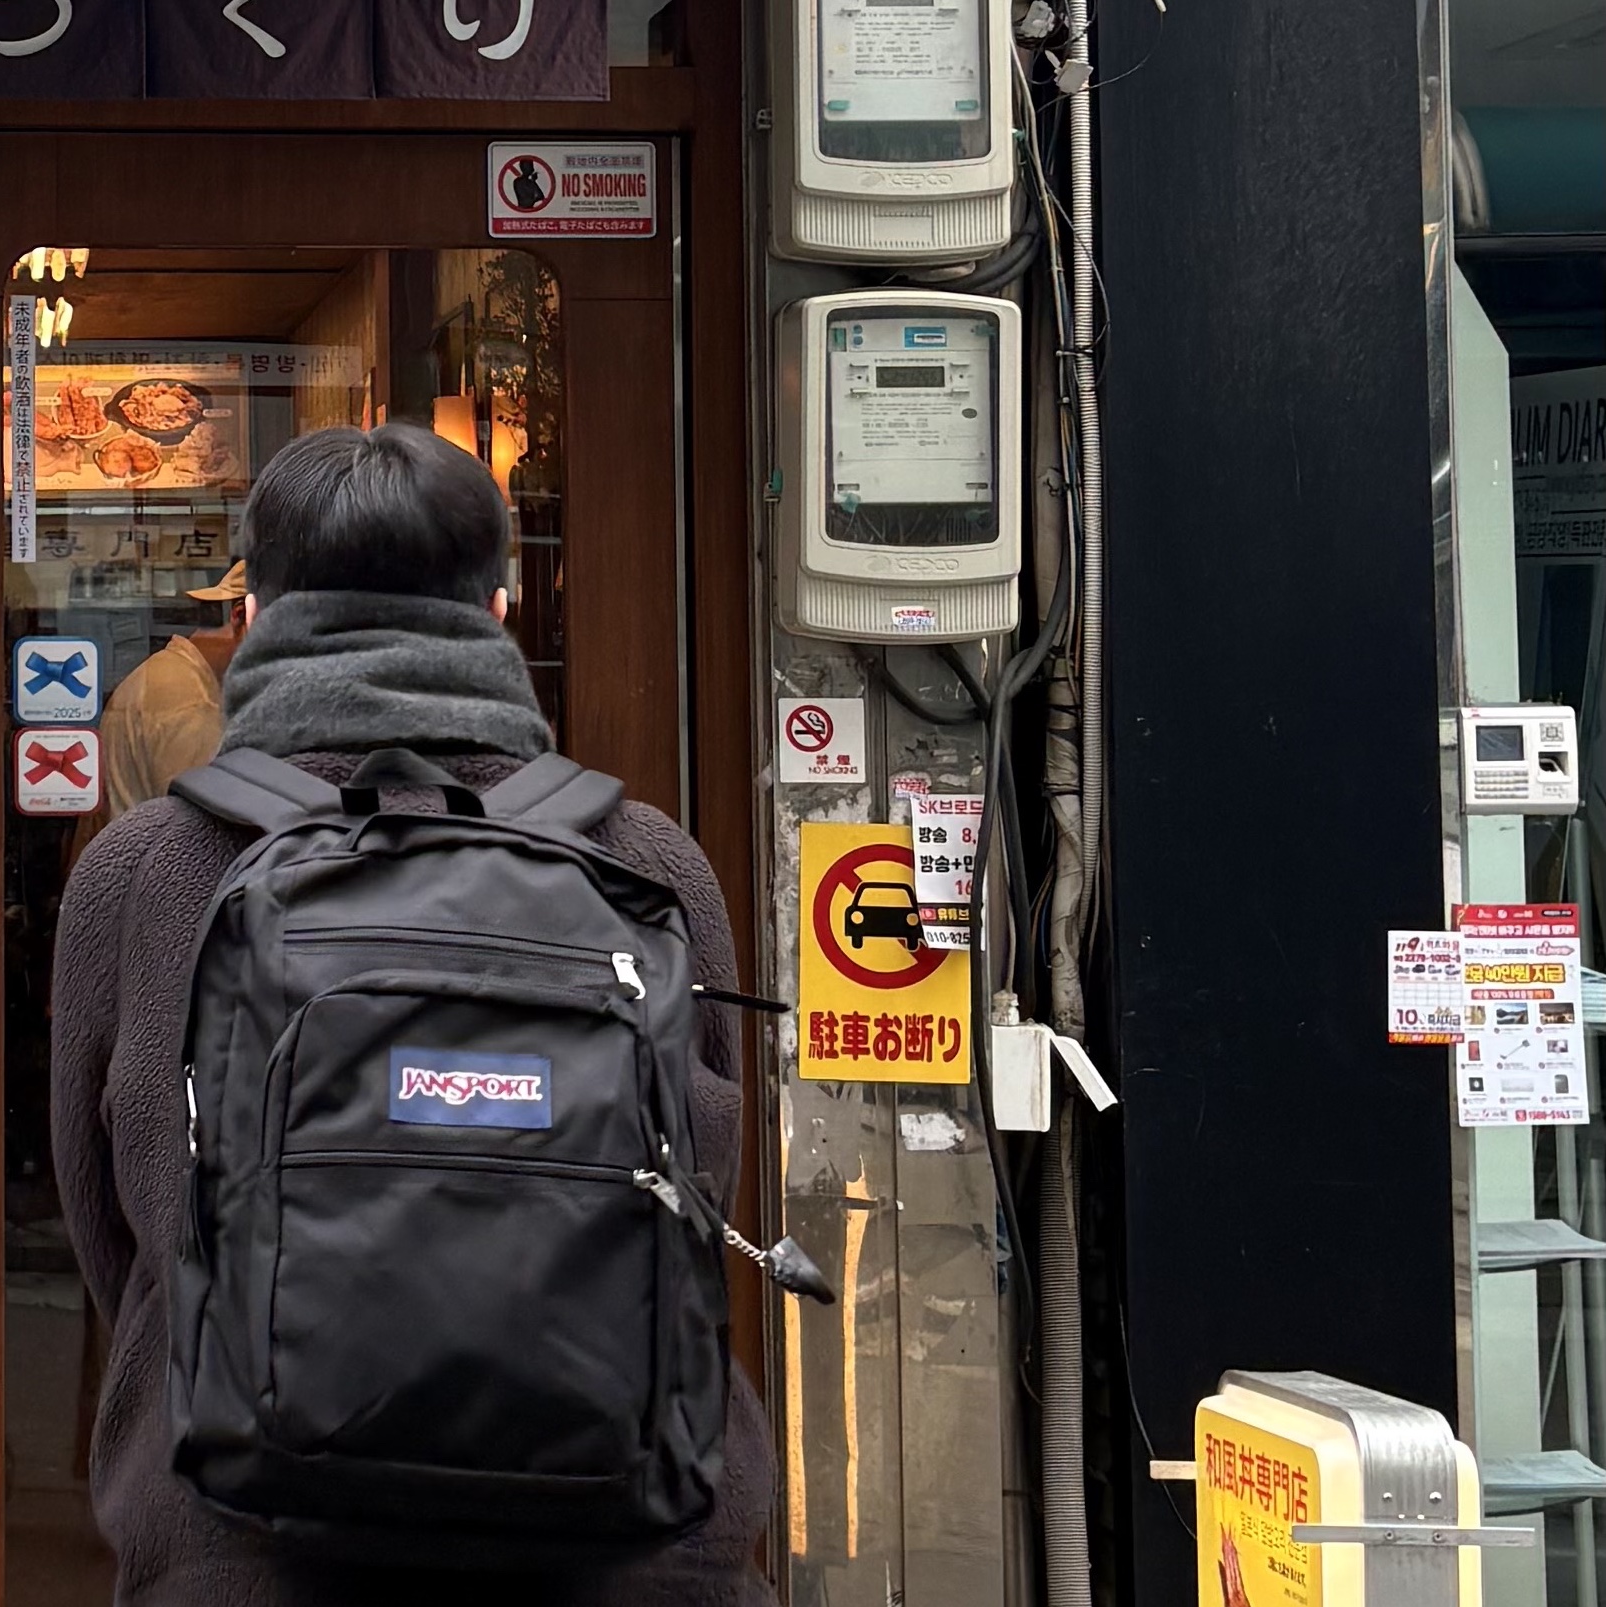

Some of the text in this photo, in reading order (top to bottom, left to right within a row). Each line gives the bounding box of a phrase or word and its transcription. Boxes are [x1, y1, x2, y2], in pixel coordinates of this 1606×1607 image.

[562, 173, 646, 197] NO SMOKING
[919, 826, 948, 843] 방송
[807, 1009, 962, 1063] 駐車お断り
[1205, 1433, 1308, 1523] 和風丼専門店
